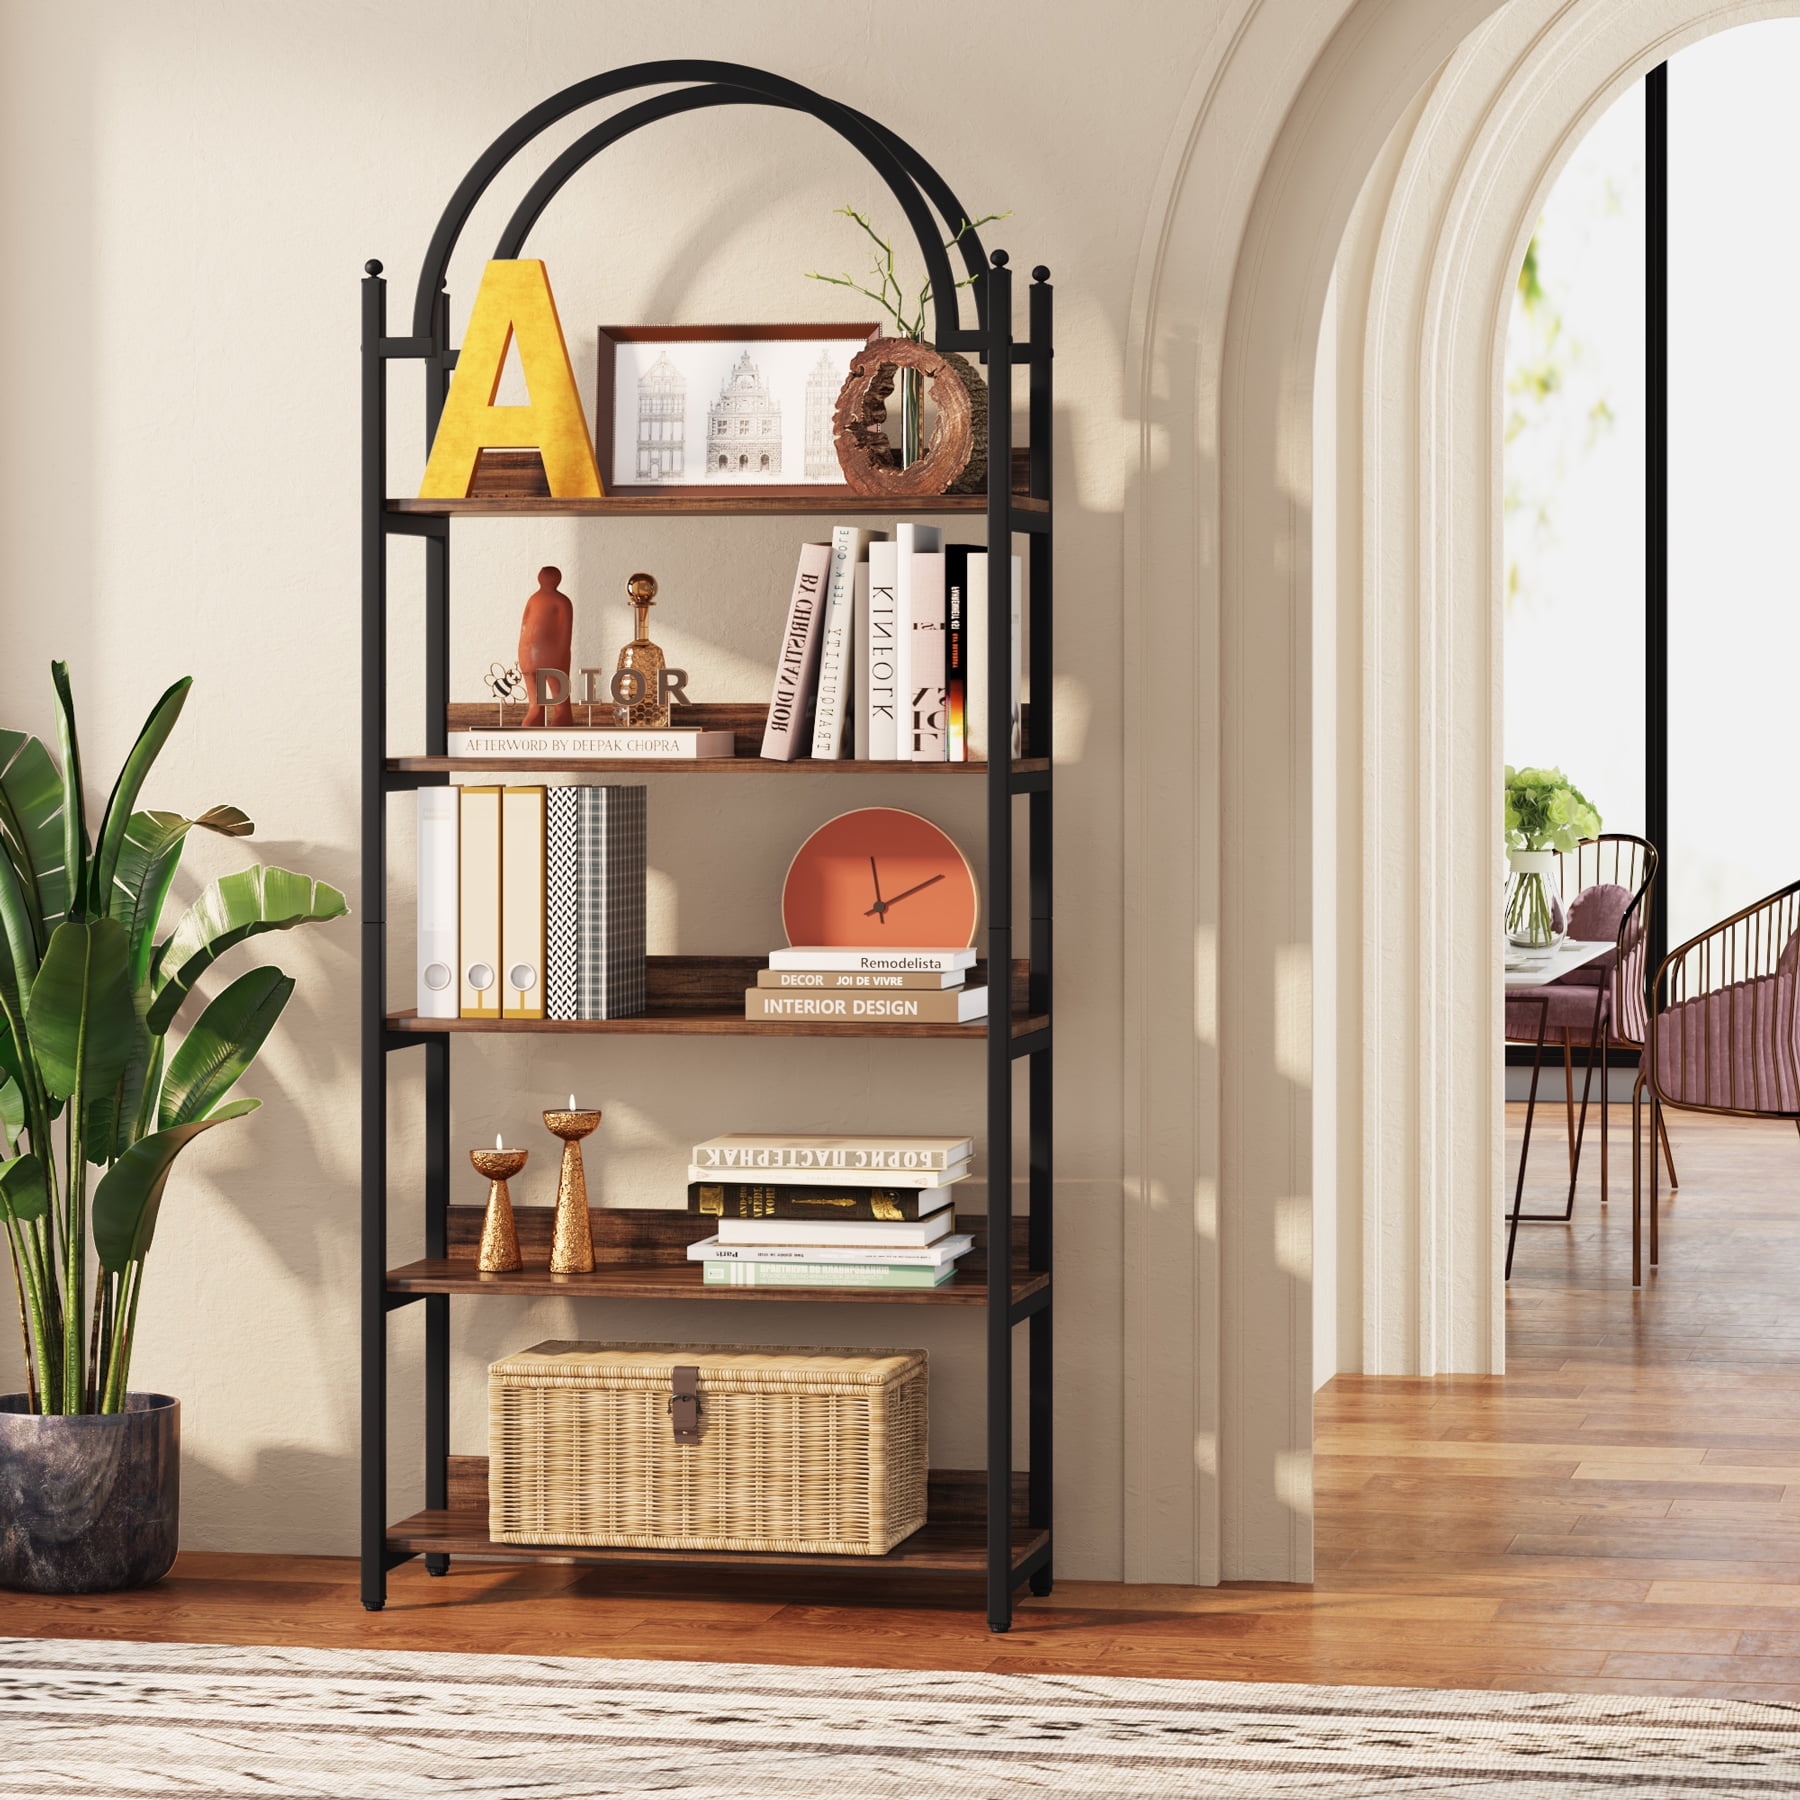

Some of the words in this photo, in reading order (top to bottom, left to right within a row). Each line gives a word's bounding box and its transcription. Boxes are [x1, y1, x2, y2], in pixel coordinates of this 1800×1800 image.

[535, 667, 693, 706] DIOR
[465, 739, 548, 752] AFTERWORD
[552, 739, 570, 752] BY
[572, 739, 623, 752] DEEPAK
[627, 739, 680, 752] CHOPRA
[860, 957, 942, 969] Remodelista
[781, 974, 824, 986] DECOR
[836, 976, 853, 986] JOI
[856, 976, 870, 986] DE
[873, 976, 903, 986] VIVRE
[764, 998, 847, 1015] INTERIOR
[853, 1000, 918, 1016] DESIGN
